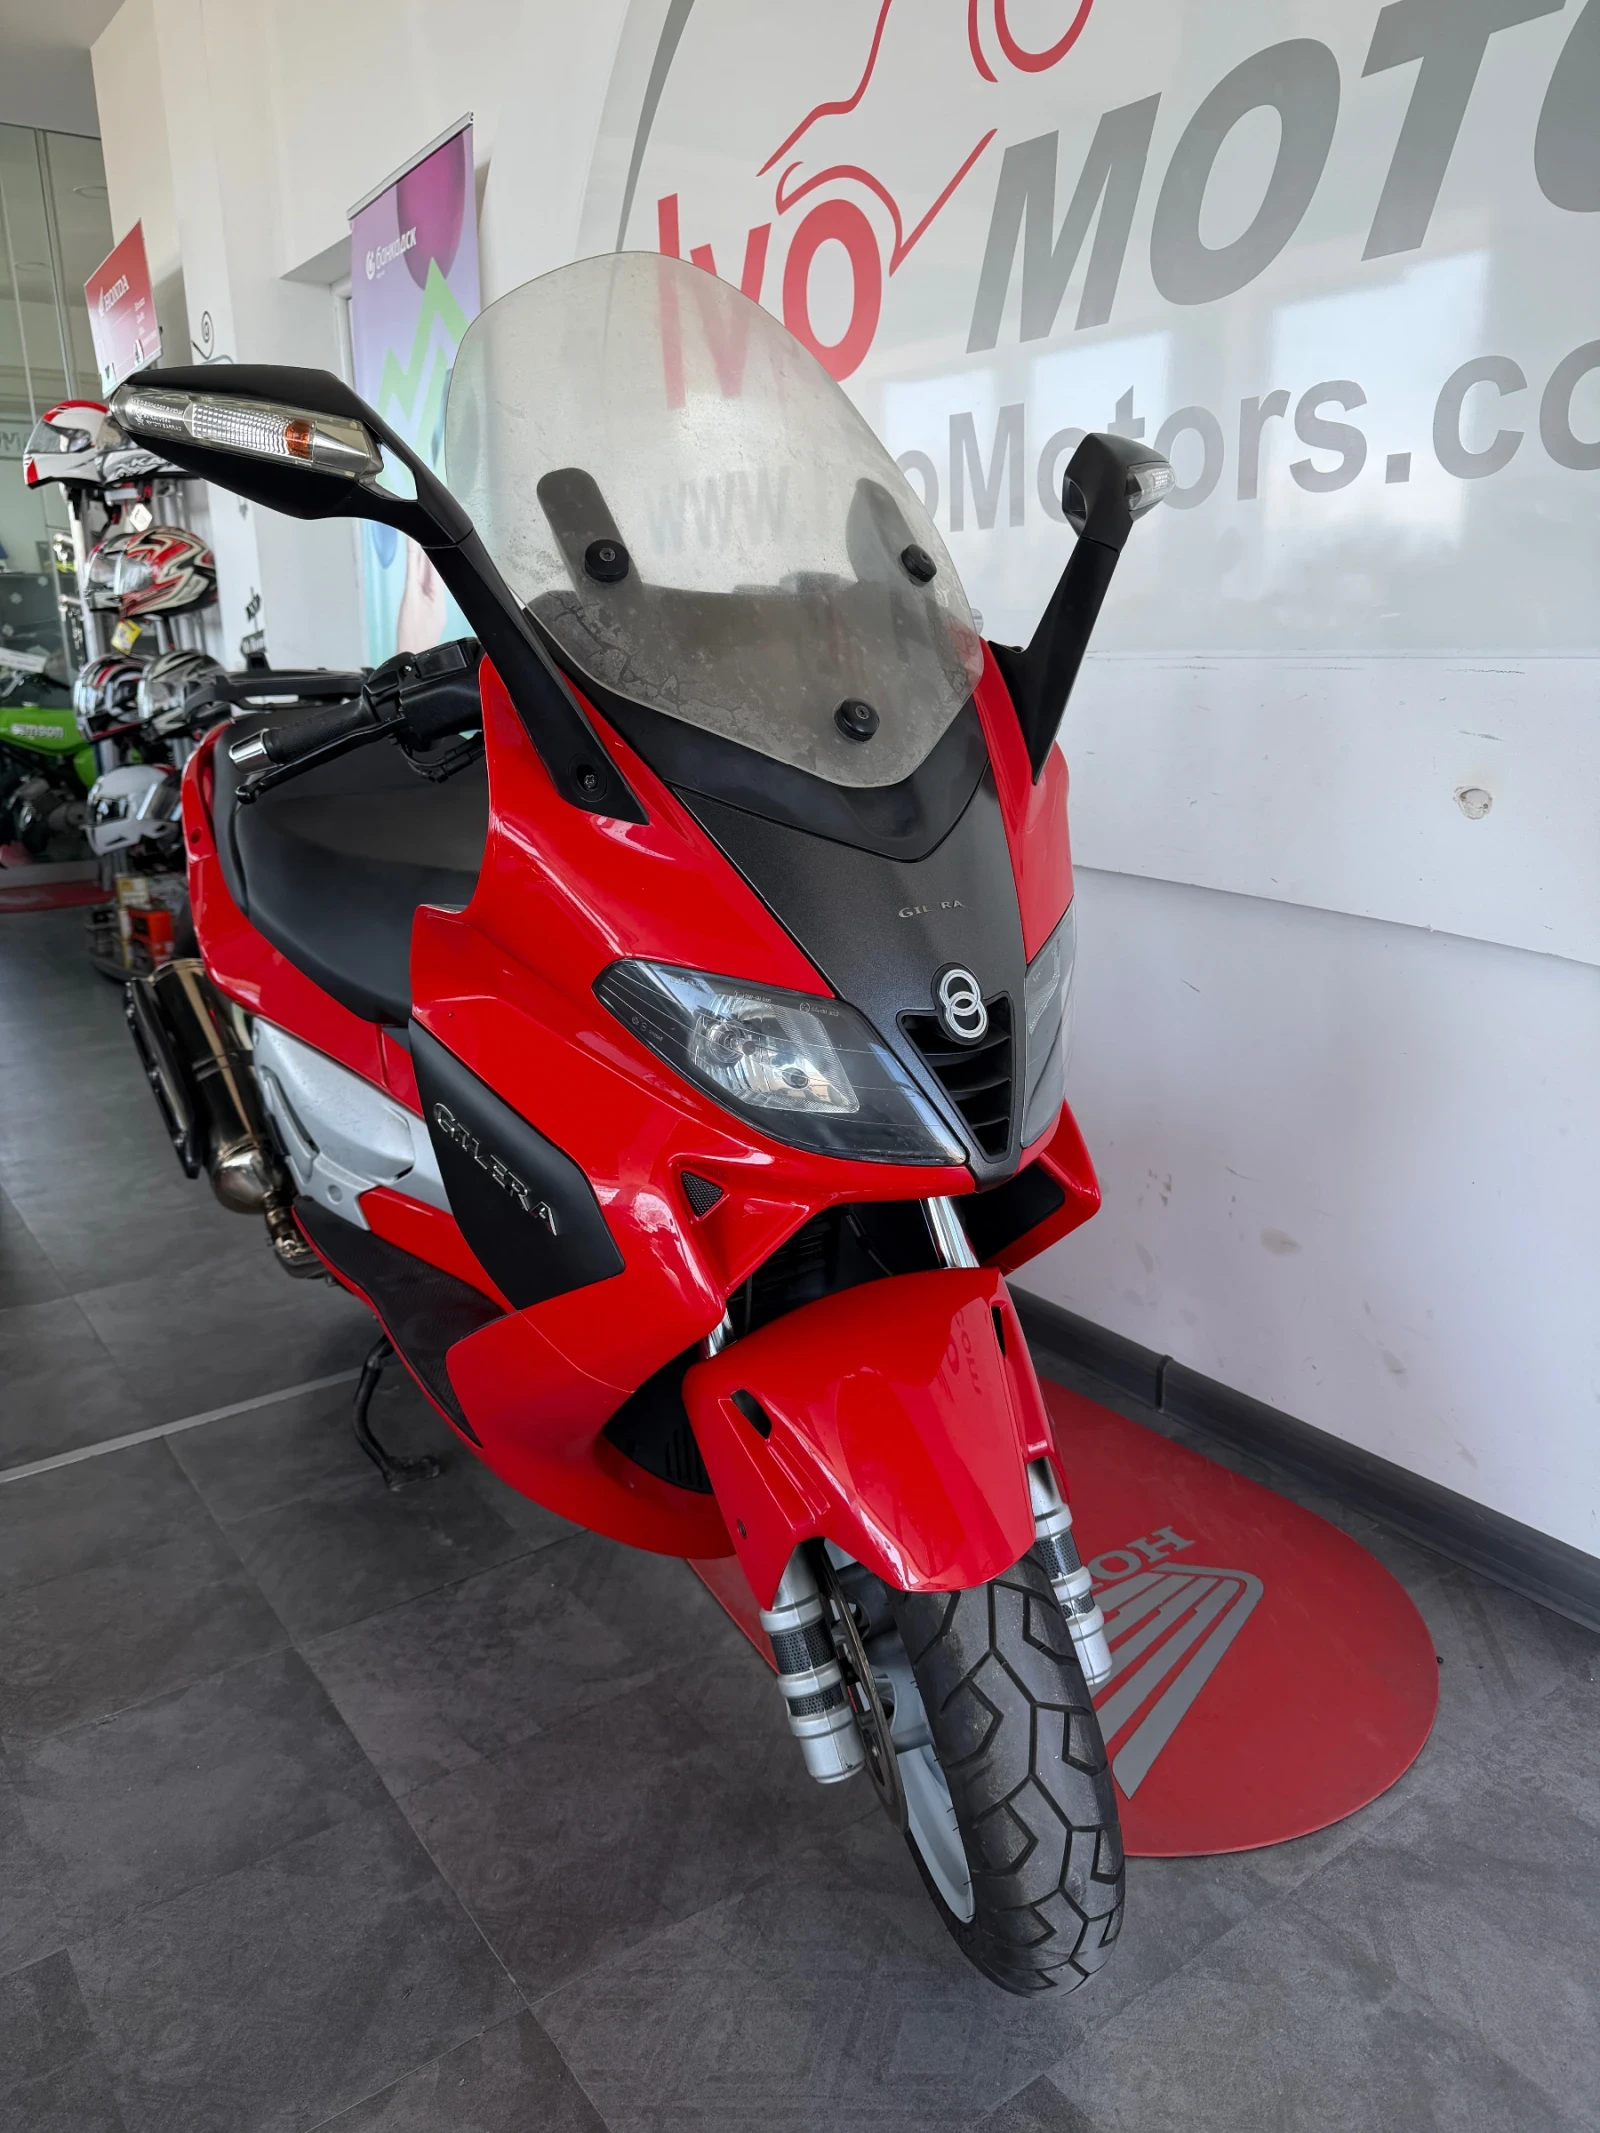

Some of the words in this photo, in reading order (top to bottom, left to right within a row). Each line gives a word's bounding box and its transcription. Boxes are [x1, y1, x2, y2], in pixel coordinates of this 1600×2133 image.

[103, 274, 130, 312] HONDA
[898, 900, 964, 918] GILRA
[433, 1102, 557, 1236] GILERA
